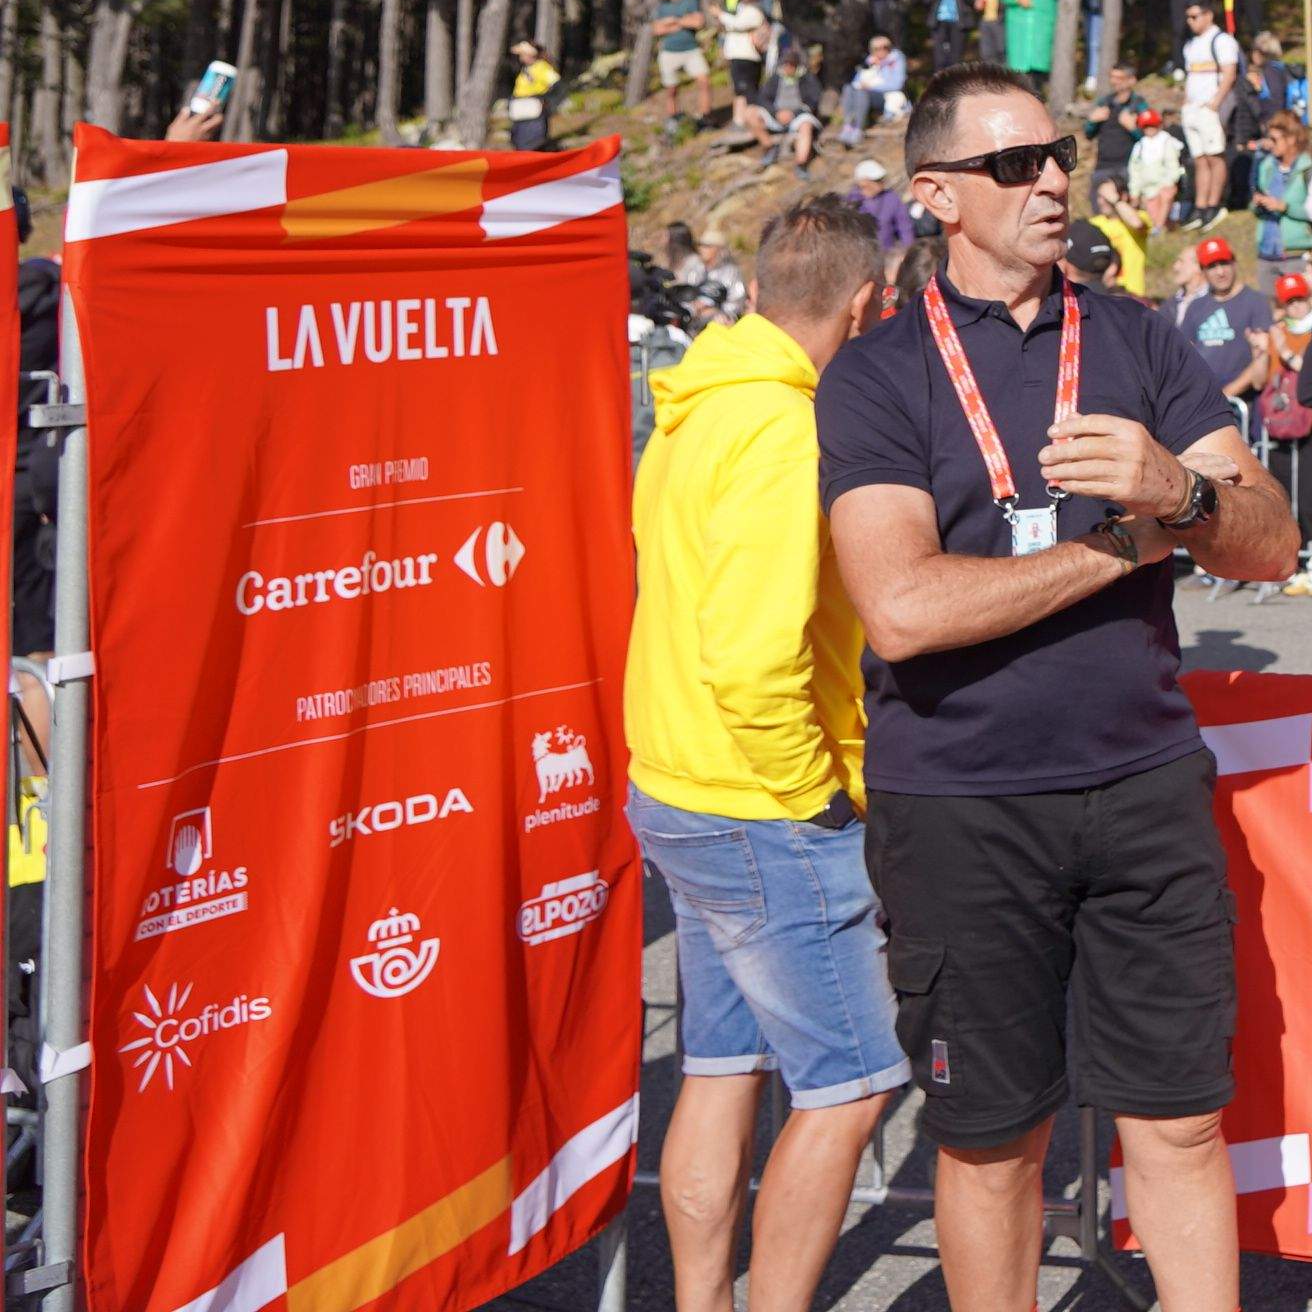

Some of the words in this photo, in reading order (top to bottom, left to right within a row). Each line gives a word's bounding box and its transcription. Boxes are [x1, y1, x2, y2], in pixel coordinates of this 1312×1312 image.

[265, 304, 325, 372] LA
[330, 296, 499, 366] VUELTA
[236, 550, 438, 616] Carrefour
[296, 676, 401, 723] PATROCORES
[403, 661, 491, 700] PRINCIPALES
[524, 796, 601, 834] plenitude
[186, 898, 239, 922] DEPORTE
[154, 993, 273, 1049] Cofidis
